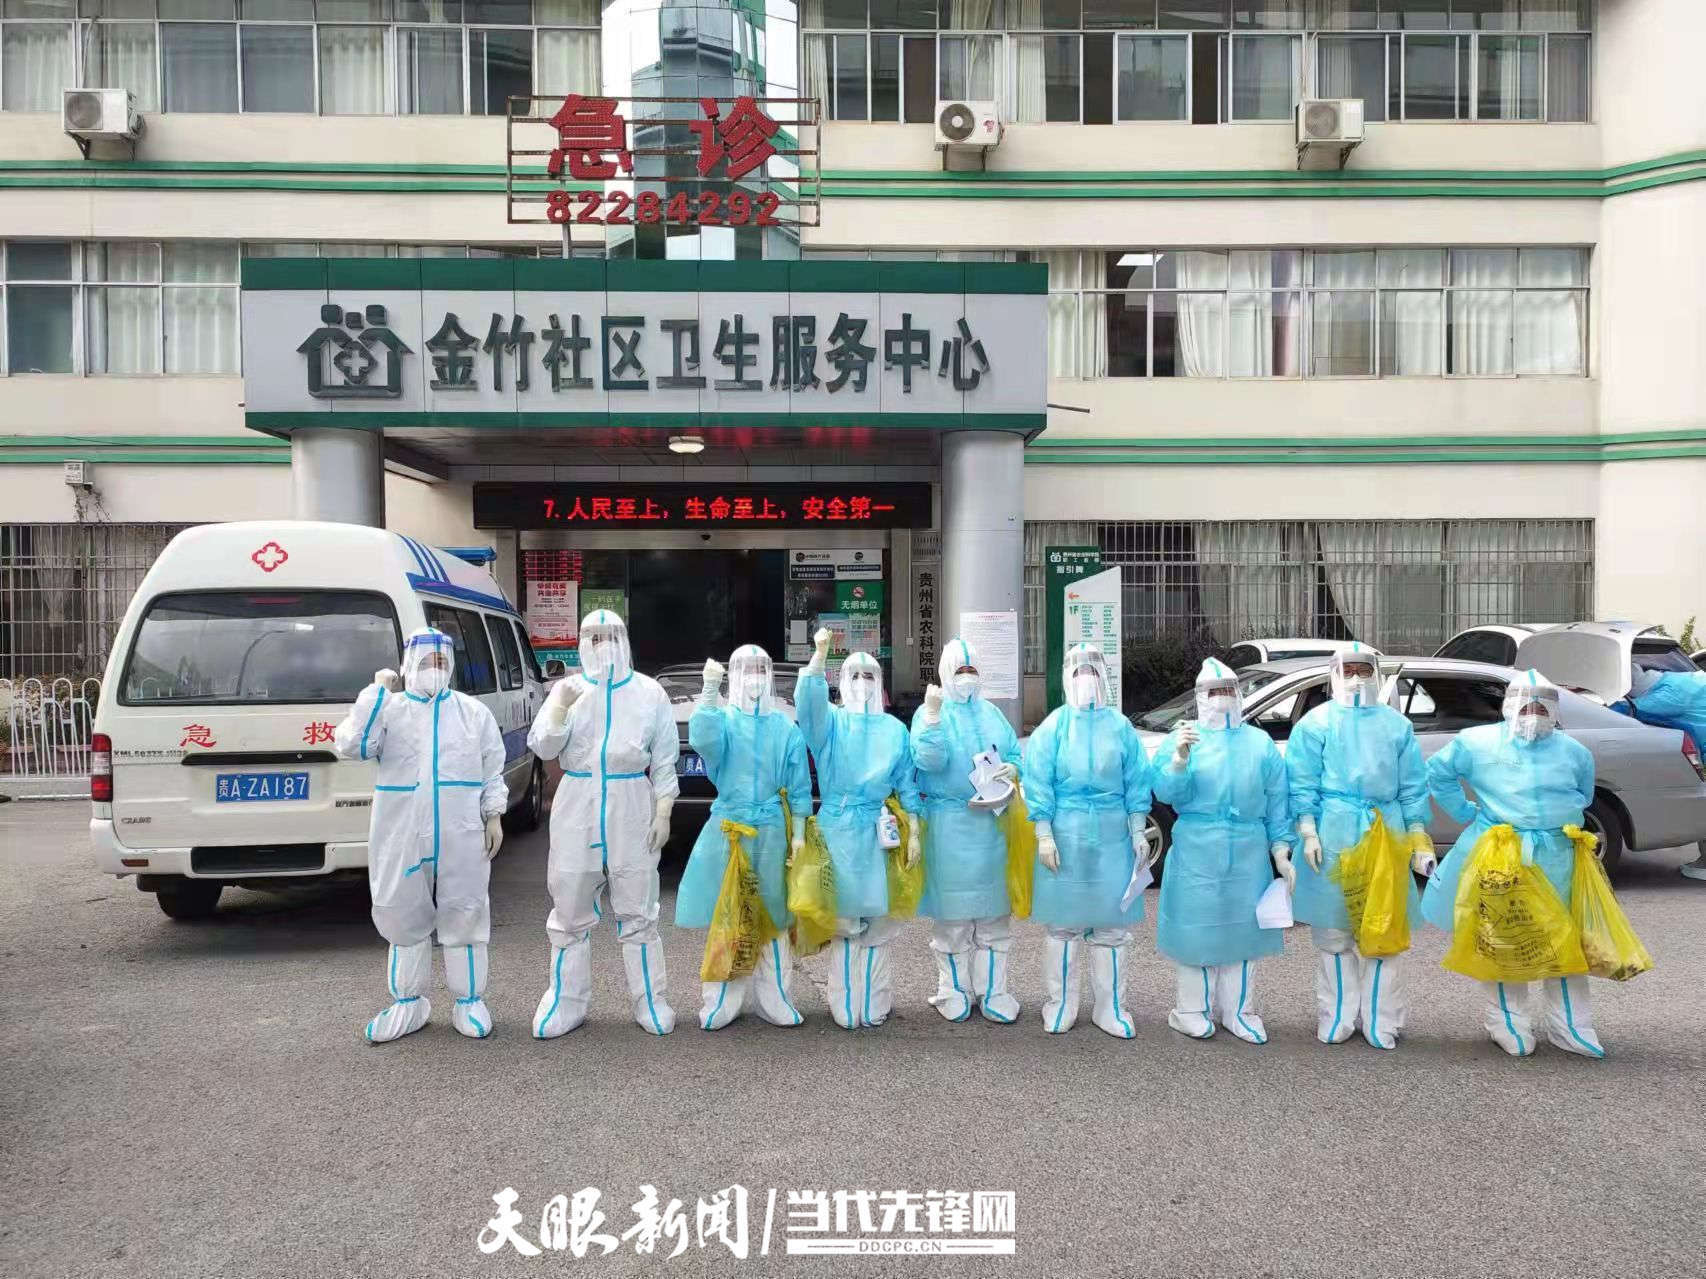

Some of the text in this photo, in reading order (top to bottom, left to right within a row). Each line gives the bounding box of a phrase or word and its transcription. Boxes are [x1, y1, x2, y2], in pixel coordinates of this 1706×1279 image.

[547, 94, 780, 181] 急诊
[547, 190, 781, 226] 82284292
[425, 312, 990, 394] 金竹社区卫生服务中心
[841, 600, 878, 610] 无烟单位
[180, 721, 337, 748] 急 救
